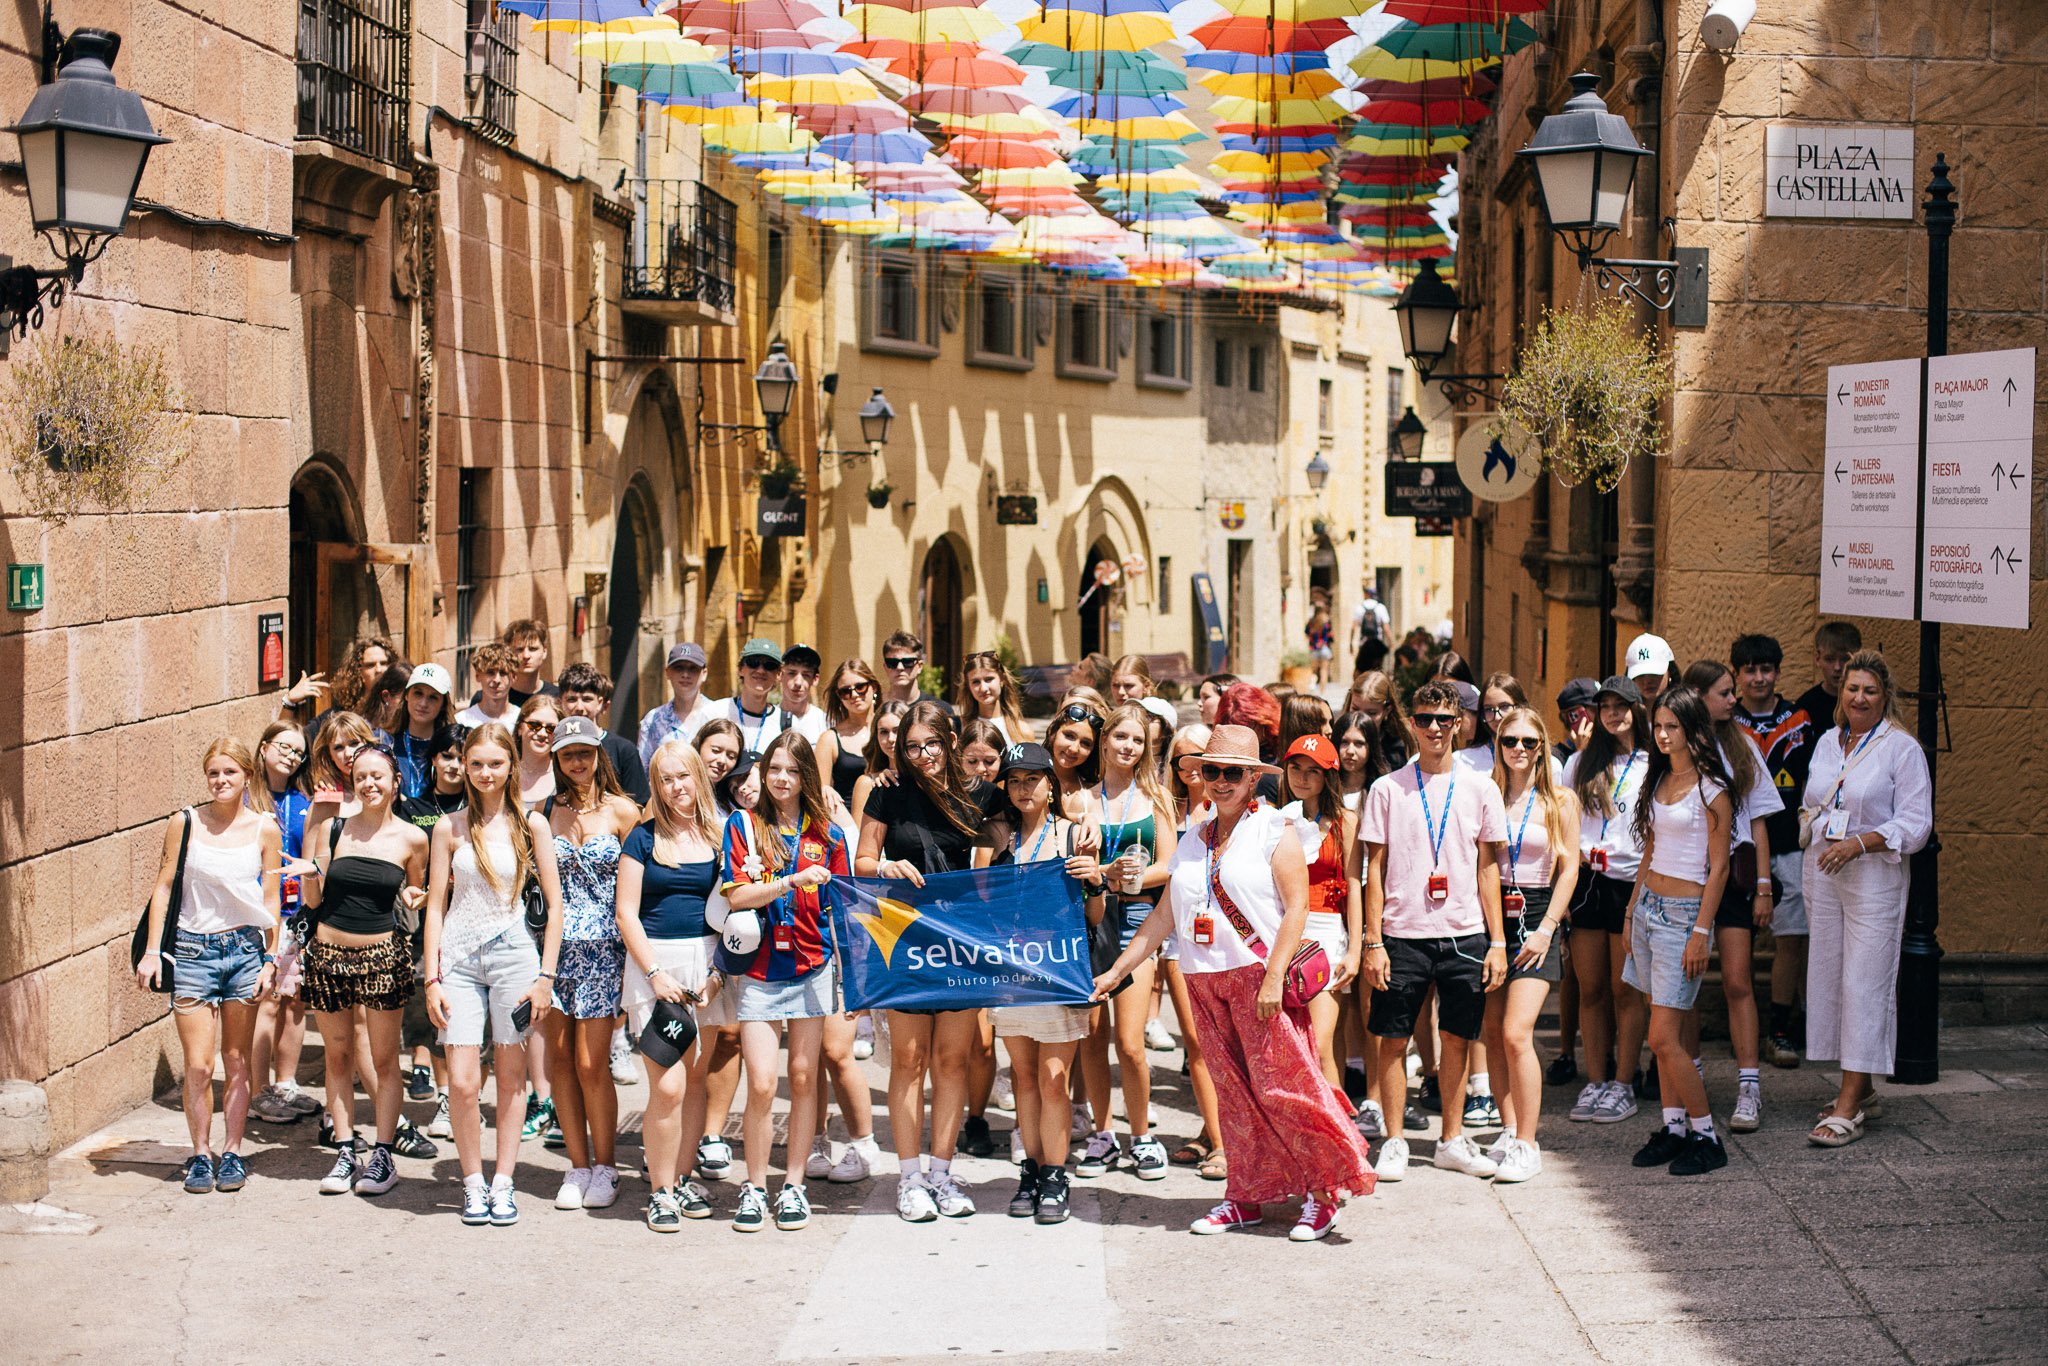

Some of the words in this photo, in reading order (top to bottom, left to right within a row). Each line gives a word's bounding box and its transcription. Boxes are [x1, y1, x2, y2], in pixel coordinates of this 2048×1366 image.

[1797, 144, 1880, 171] PLAZA
[1777, 175, 1904, 202] CASTELLANA
[1854, 378, 1890, 392] MONESTIR
[1934, 380, 1960, 396] PLAÇA
[1960, 378, 1989, 392] MAJOR
[1853, 392, 1886, 408] ROMÀNIC
[1934, 400, 1948, 409] Plaza
[1948, 400, 1964, 410] Mayor
[1934, 413, 1946, 422] Main
[1947, 412, 1965, 422] Square
[1873, 424, 1898, 434] Monastery
[1852, 458, 1881, 471] TALLERS
[1932, 462, 1962, 477] FIESTA
[1851, 472, 1896, 486] D'ARTESANIA
[1932, 485, 1952, 496] Espacio
[1960, 496, 1989, 506] experience
[1849, 542, 1874, 555] MUSEU
[1930, 543, 1971, 558] EXPOSICIÓ
[1848, 557, 1867, 569] FRAN
[1868, 558, 1895, 571] DAUREL
[1930, 559, 1983, 574] FOTOGRÀFICA
[565, 721, 581, 735] M
[1302, 737, 1319, 752] NY
[1009, 744, 1025, 762] NY
[727, 934, 742, 951] NY
[947, 976, 987, 987] biuro
[663, 1019, 683, 1040] NY
